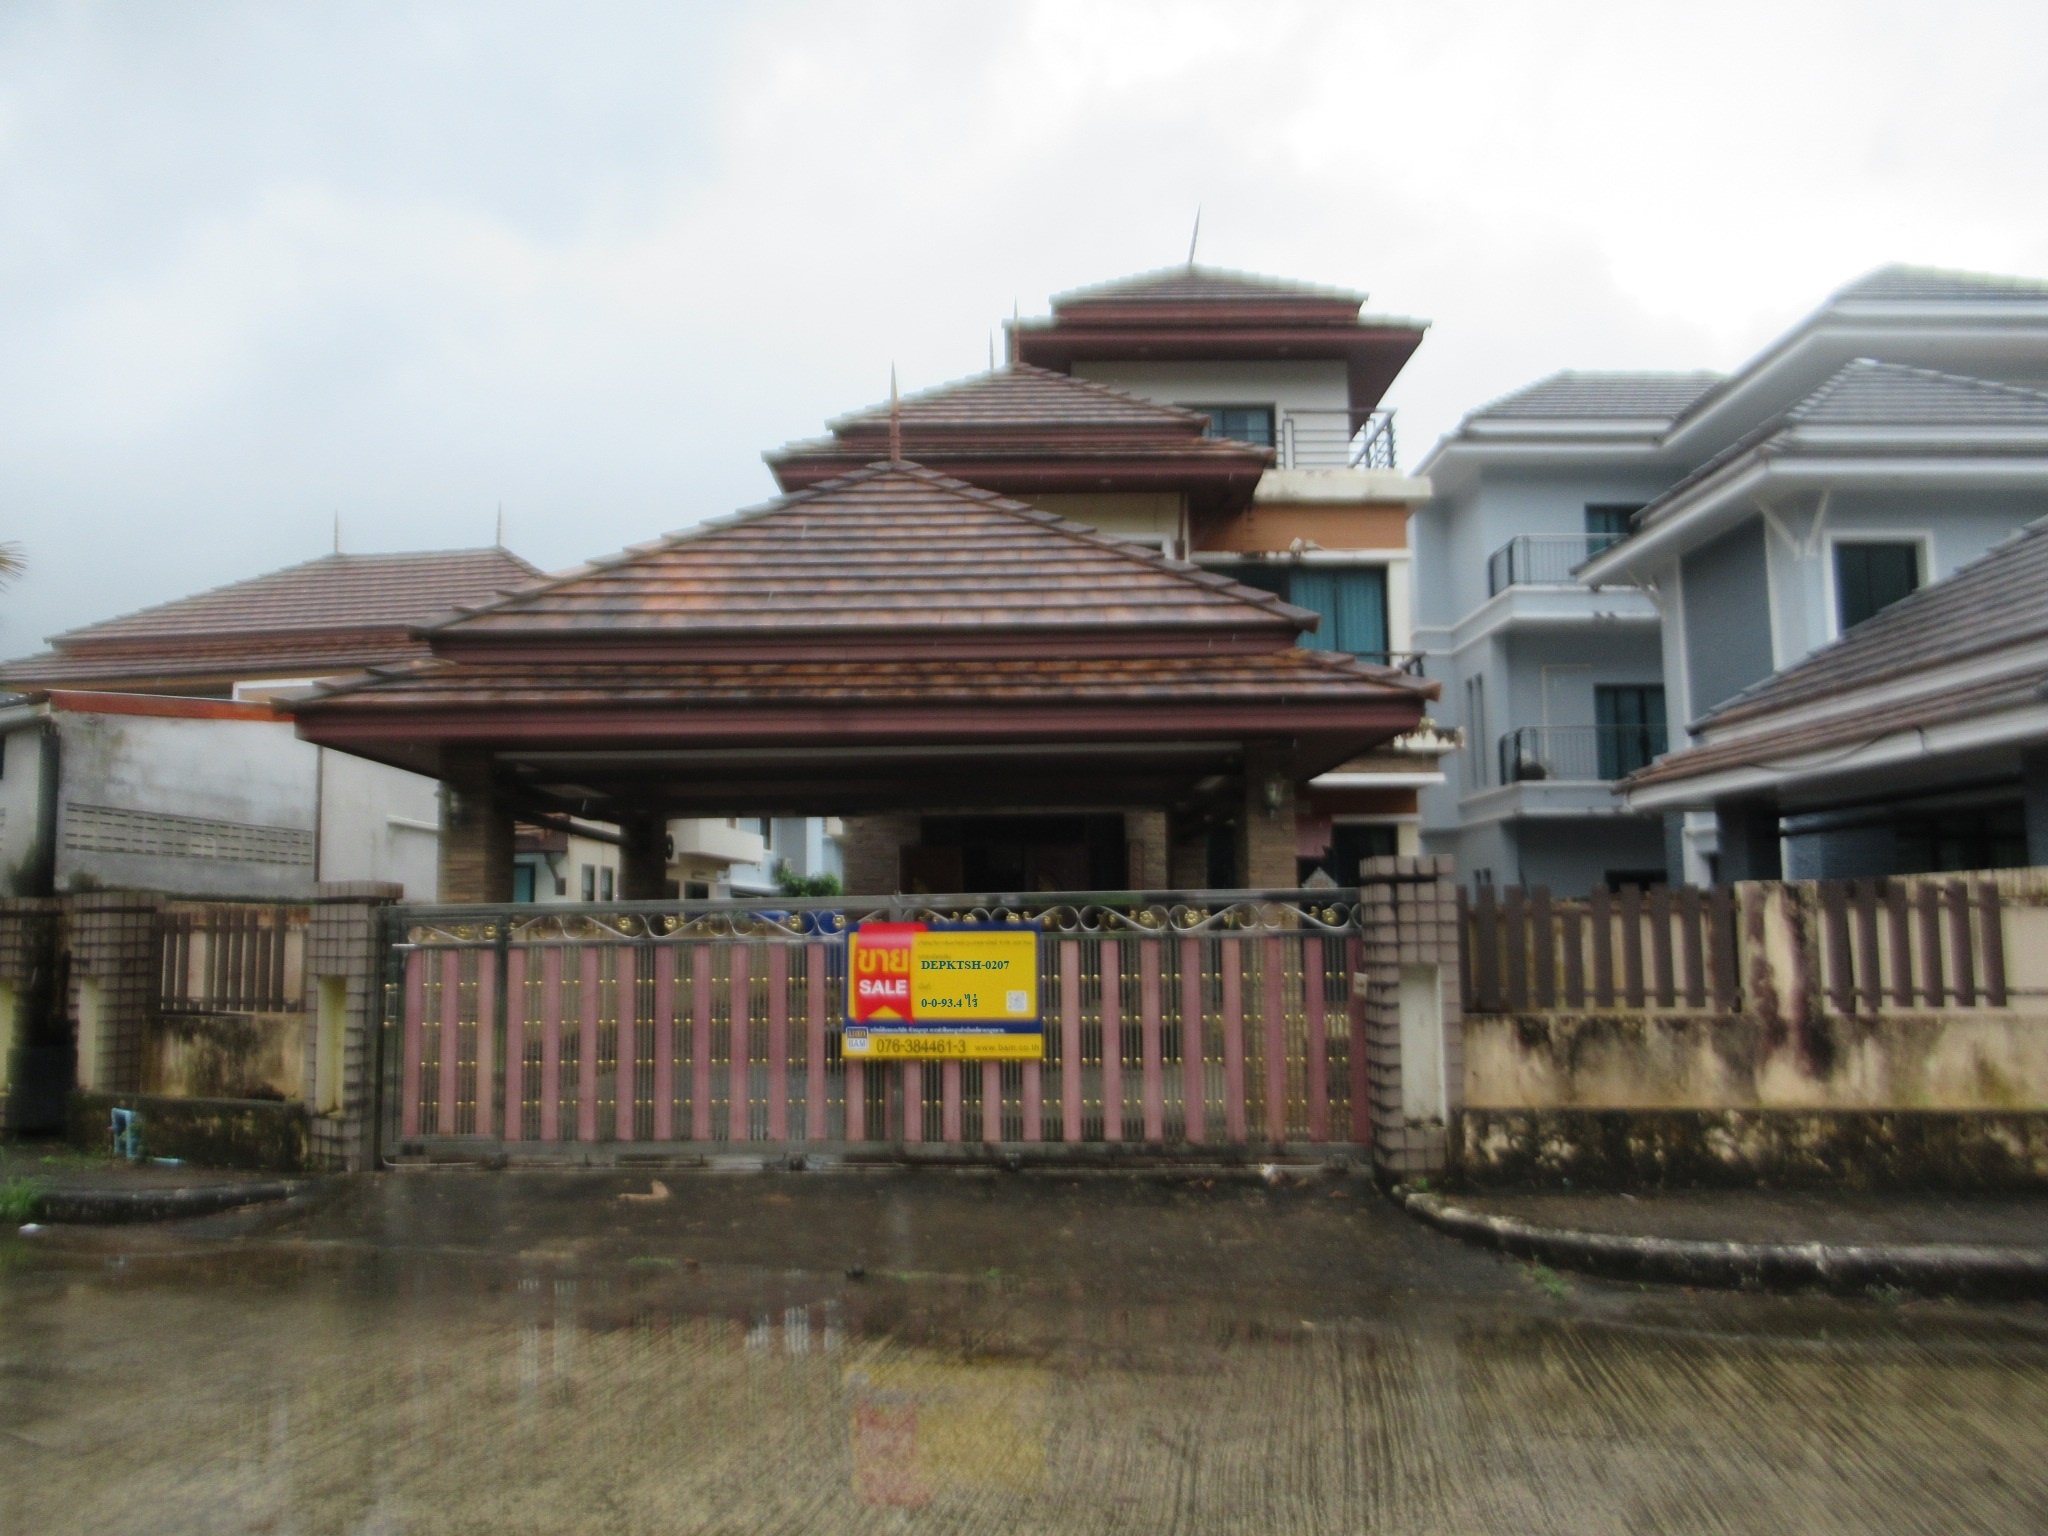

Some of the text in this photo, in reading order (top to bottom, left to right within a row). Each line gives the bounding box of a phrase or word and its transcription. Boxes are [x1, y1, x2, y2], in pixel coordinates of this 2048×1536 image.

[858, 948, 908, 972] ขาย
[859, 979, 907, 994] SALE
[848, 1039, 866, 1048] BAM
[877, 1038, 966, 1053] 076-384461-3
[974, 1043, 1040, 1052] www.bam.co.th
